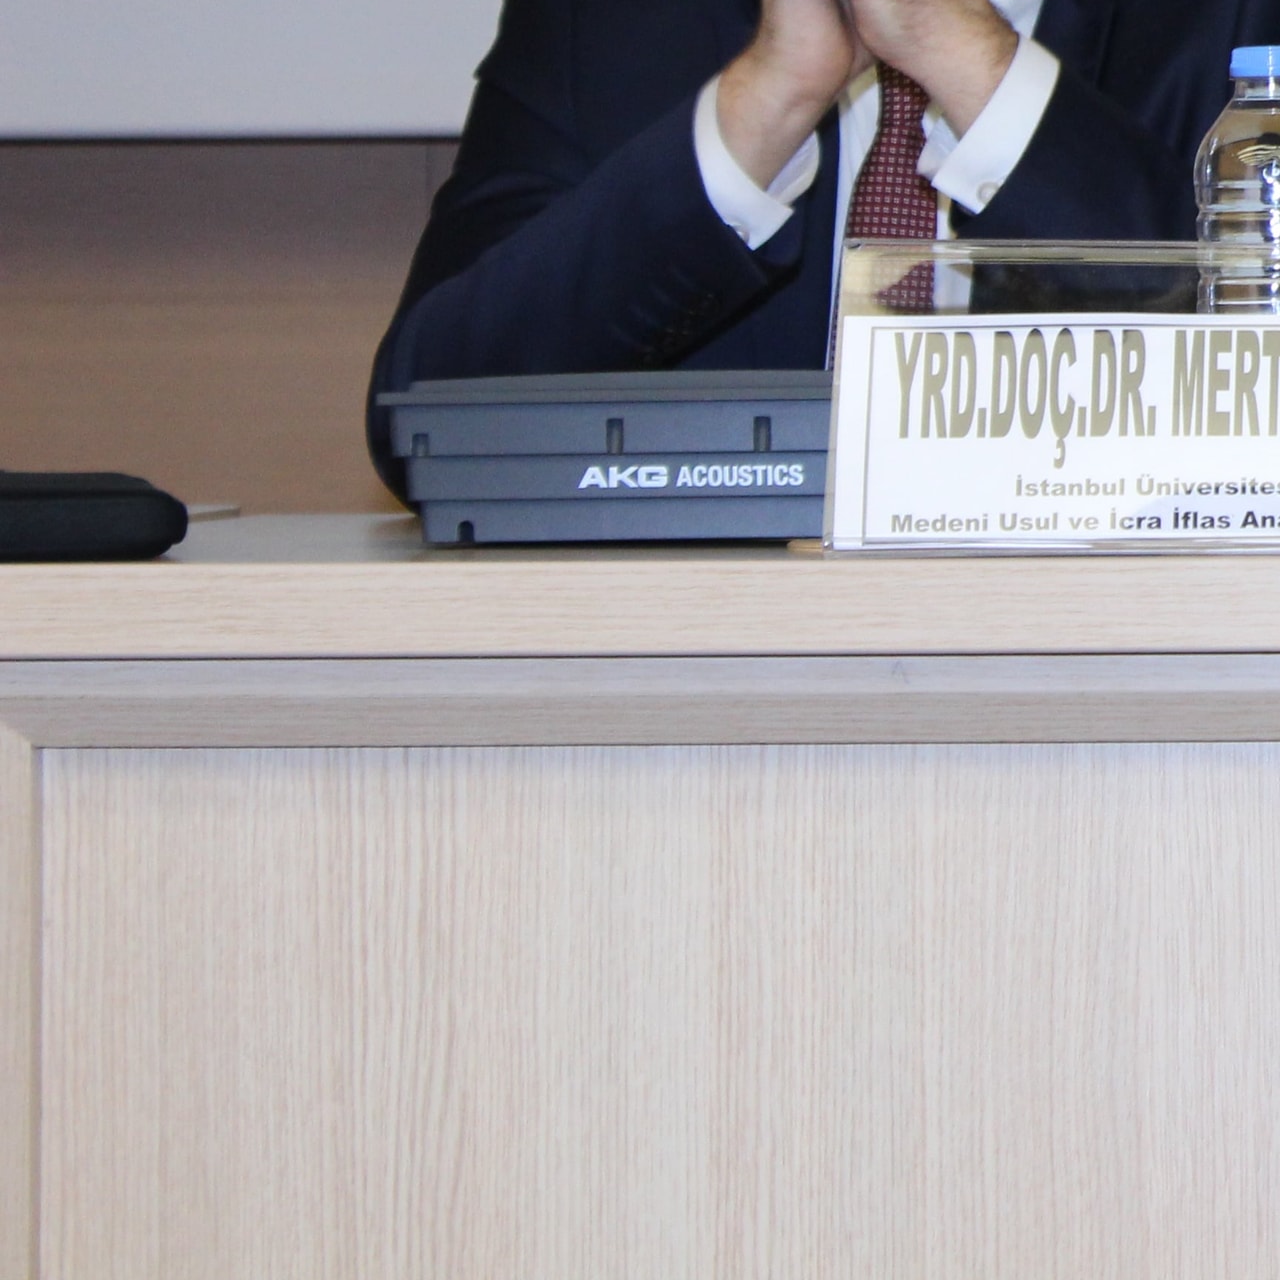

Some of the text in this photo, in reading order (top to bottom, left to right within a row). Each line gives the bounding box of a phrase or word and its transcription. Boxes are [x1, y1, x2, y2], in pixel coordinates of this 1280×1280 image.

[893, 327, 1157, 469] YRD.DOÇ.DR.
[577, 463, 806, 489] AKG ACOUSTICS
[1015, 473, 1126, 497] İstanbul
[890, 512, 990, 534] Medeni
[999, 511, 1060, 533] Usul
[1068, 516, 1100, 532] ve
[1109, 509, 1163, 531] İcra
[1172, 508, 1232, 531] İflas
